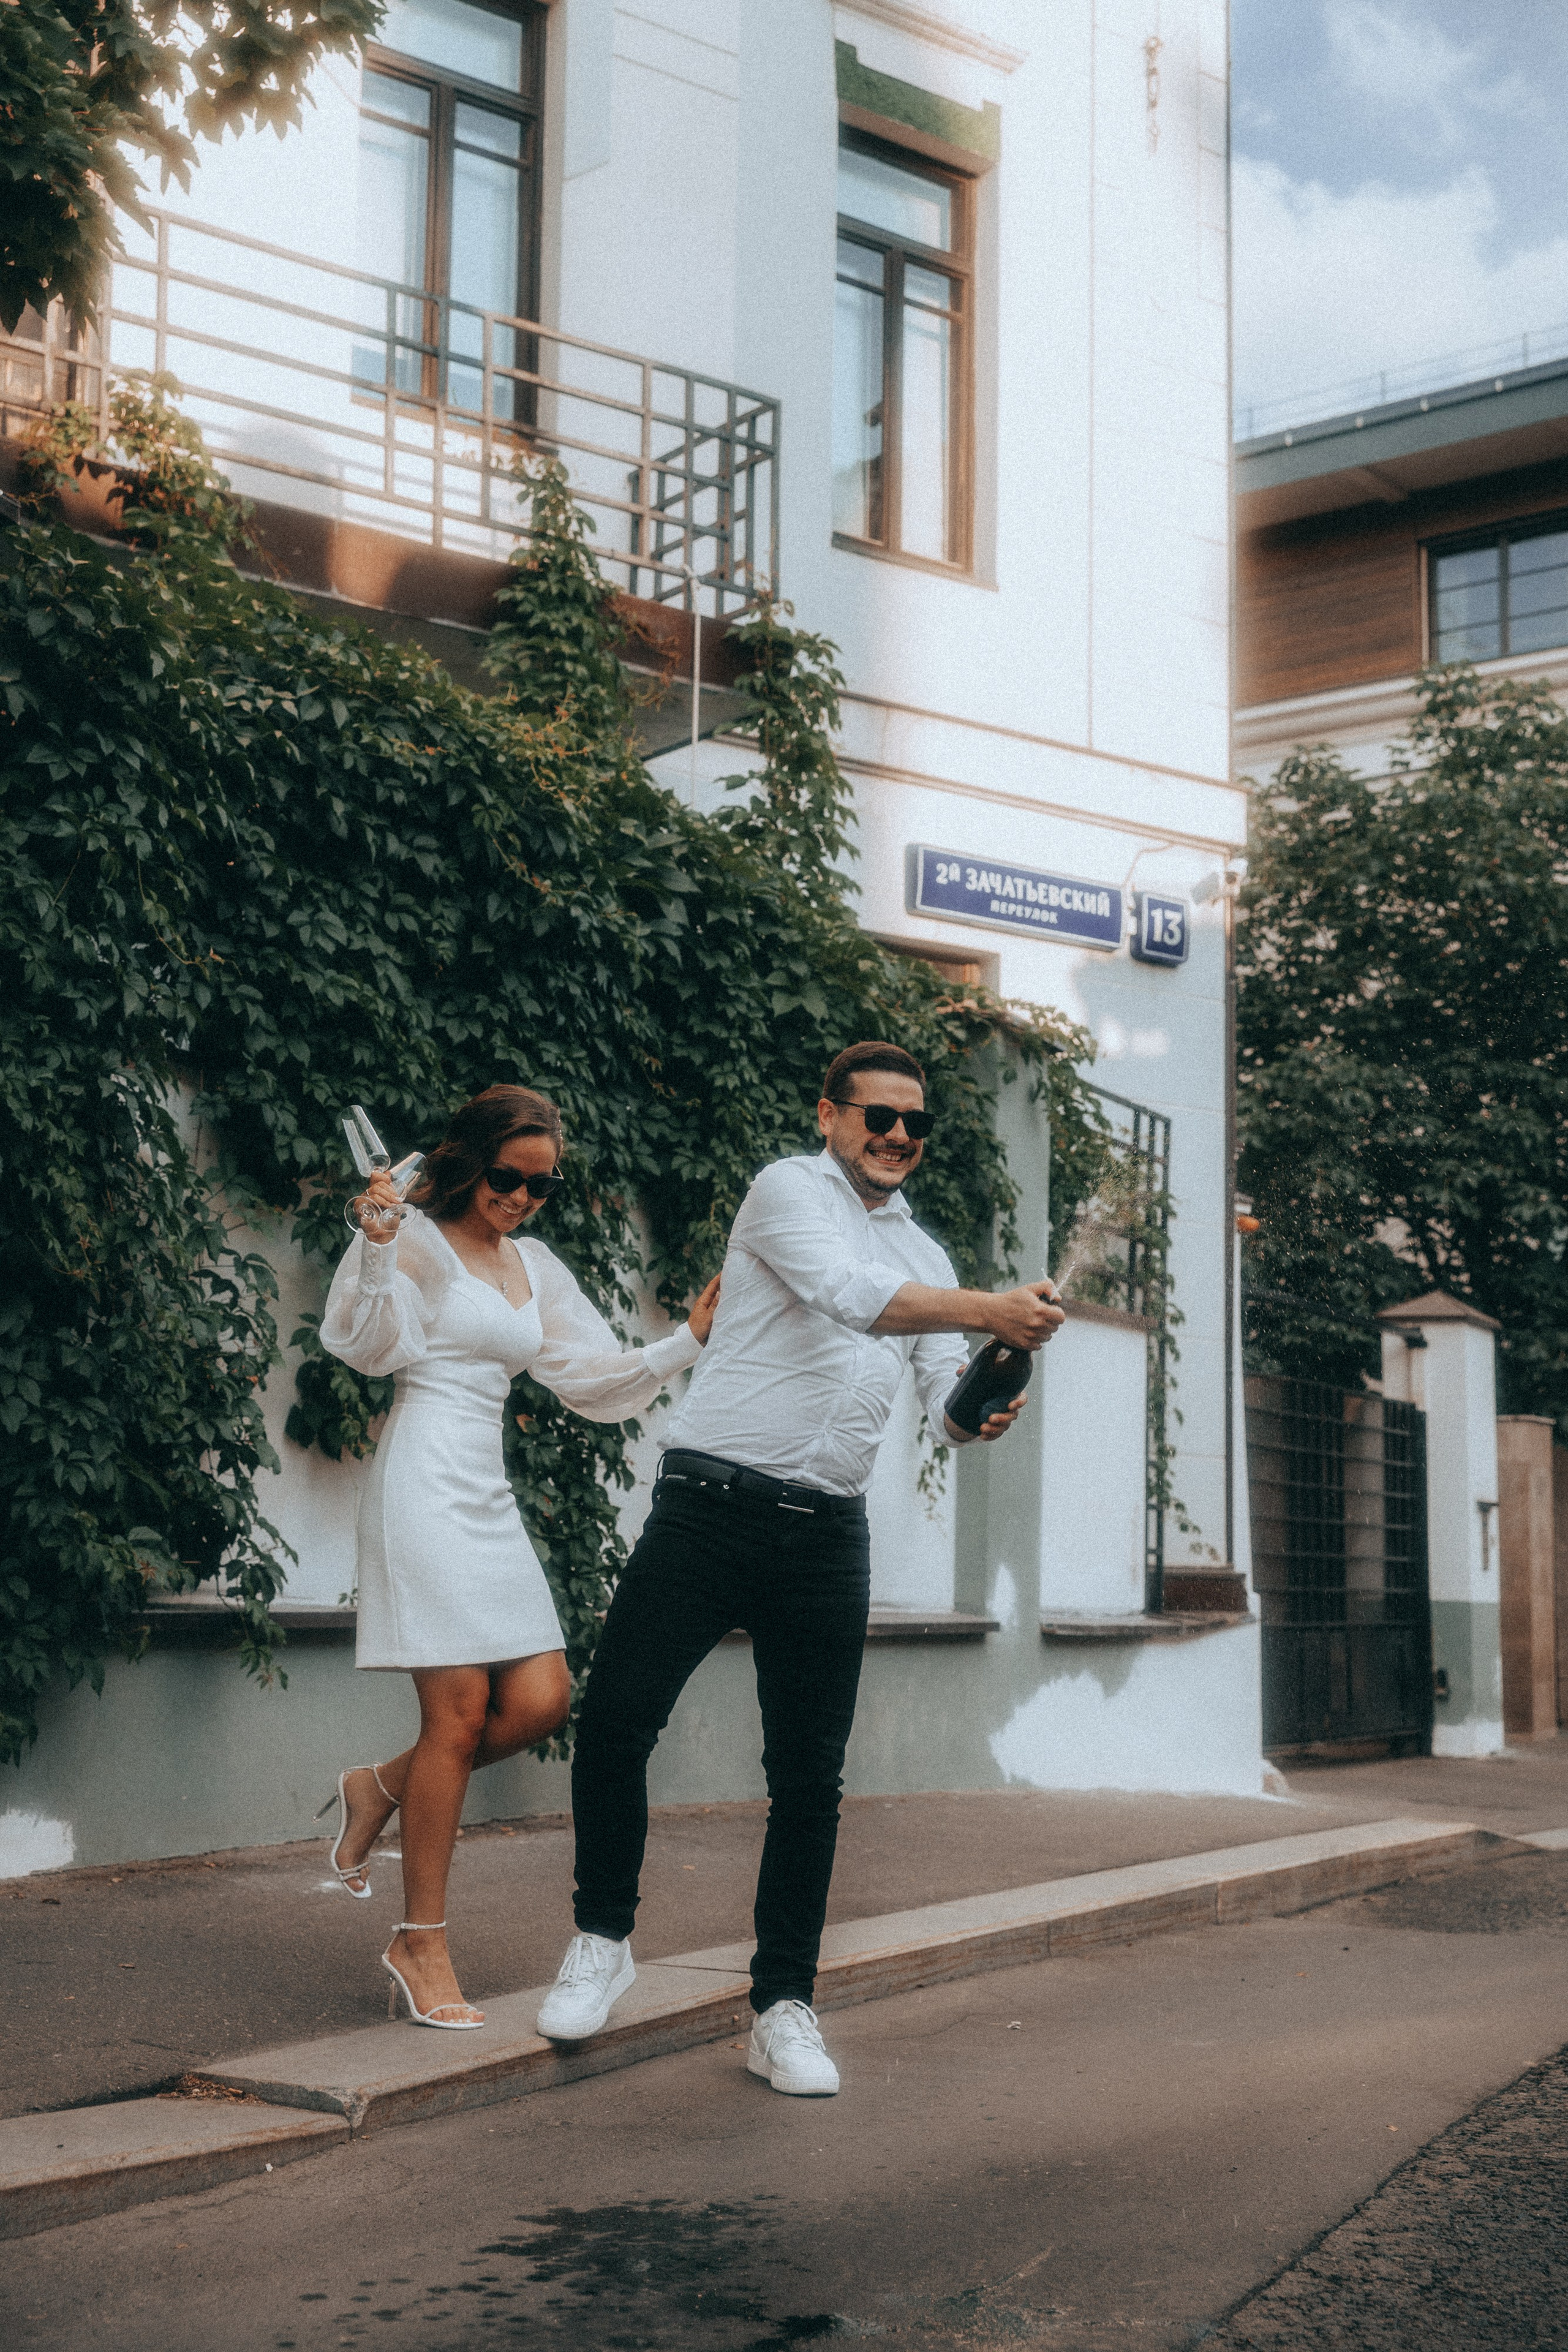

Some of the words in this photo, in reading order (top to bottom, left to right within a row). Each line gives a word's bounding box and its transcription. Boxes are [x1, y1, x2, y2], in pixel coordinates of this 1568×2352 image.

[965, 867, 1110, 918] ЗАЧАТЬЕВСКИЙ
[990, 899, 1058, 924] ПЕРЕУЛОК
[1150, 908, 1182, 946] 13
